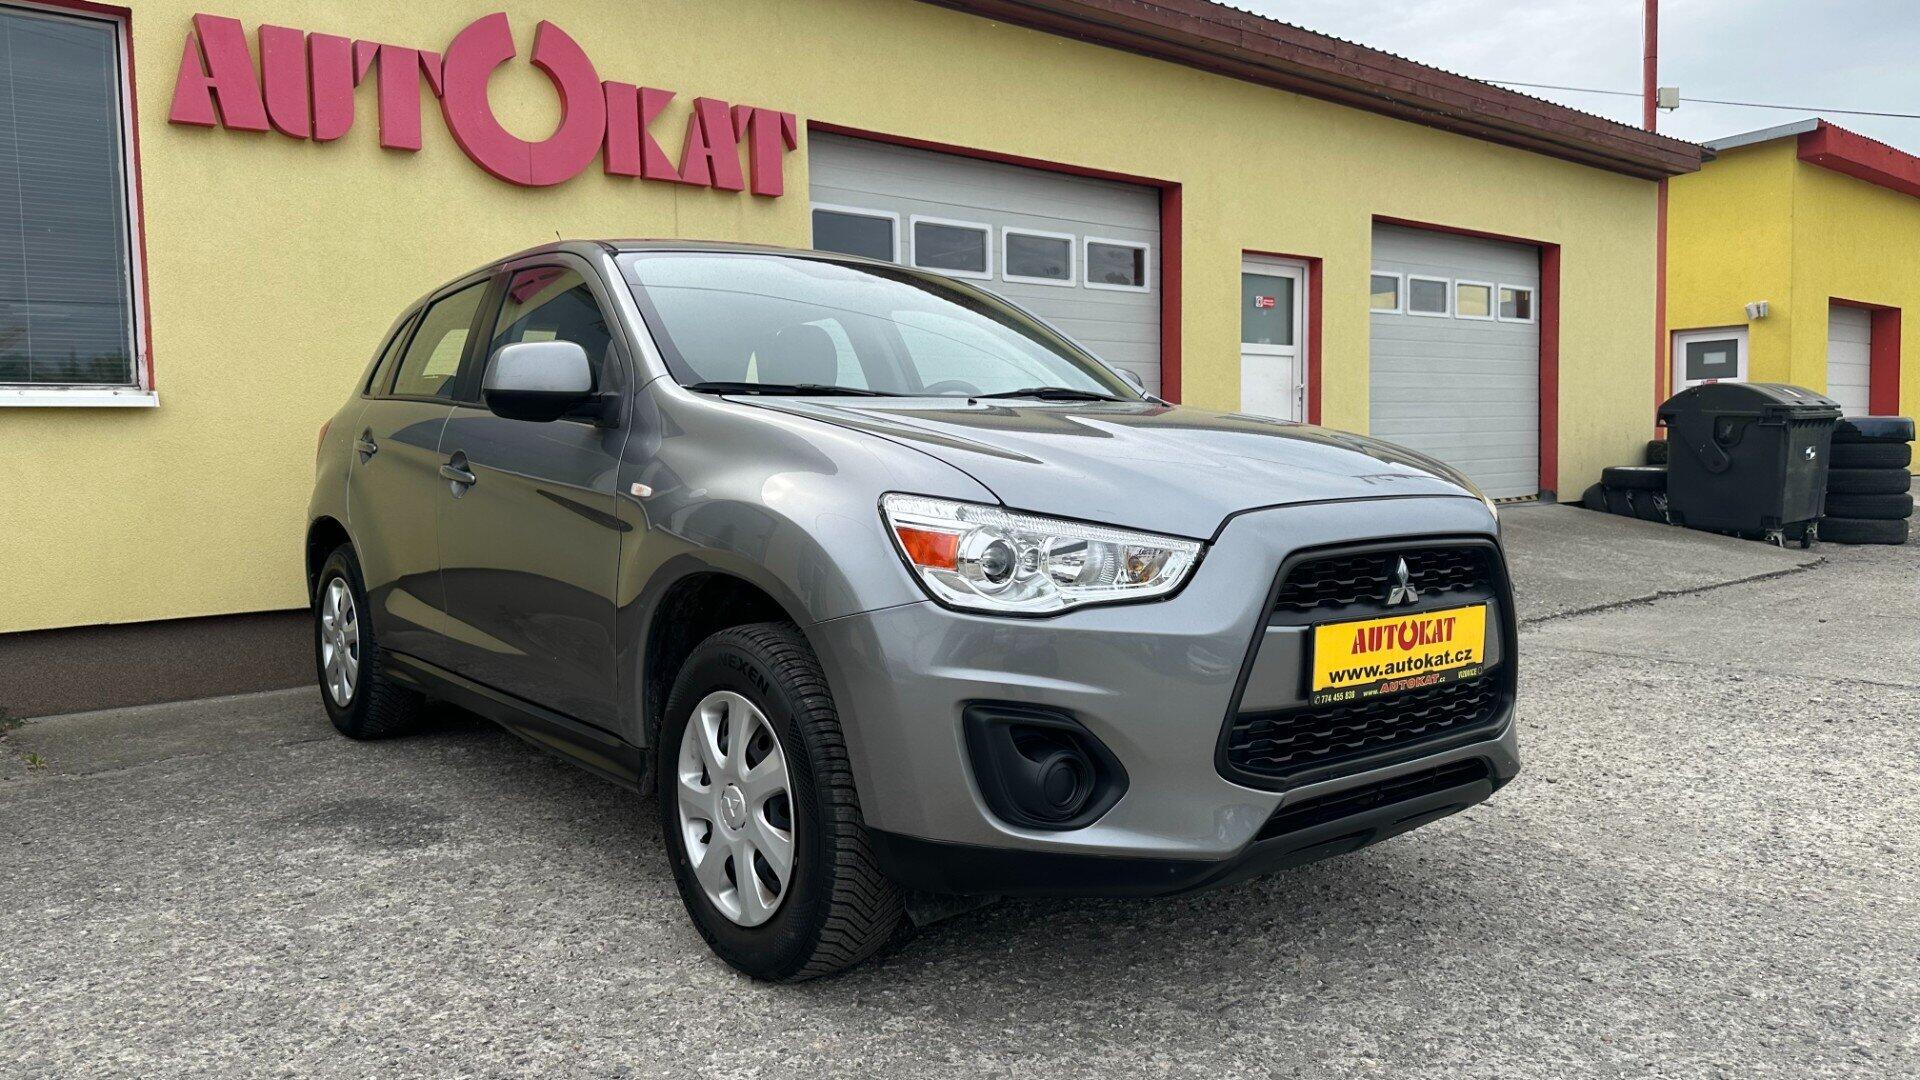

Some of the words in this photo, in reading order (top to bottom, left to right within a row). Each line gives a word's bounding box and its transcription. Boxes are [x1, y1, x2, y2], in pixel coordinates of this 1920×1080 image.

[168, 11, 797, 198] AUTOKAT
[1351, 616, 1456, 655] AUTOKAT
[719, 652, 770, 696] NEXEN
[1329, 648, 1472, 684] www.autokat.cz
[1321, 694, 1332, 704] 774
[1333, 692, 1343, 702] 455
